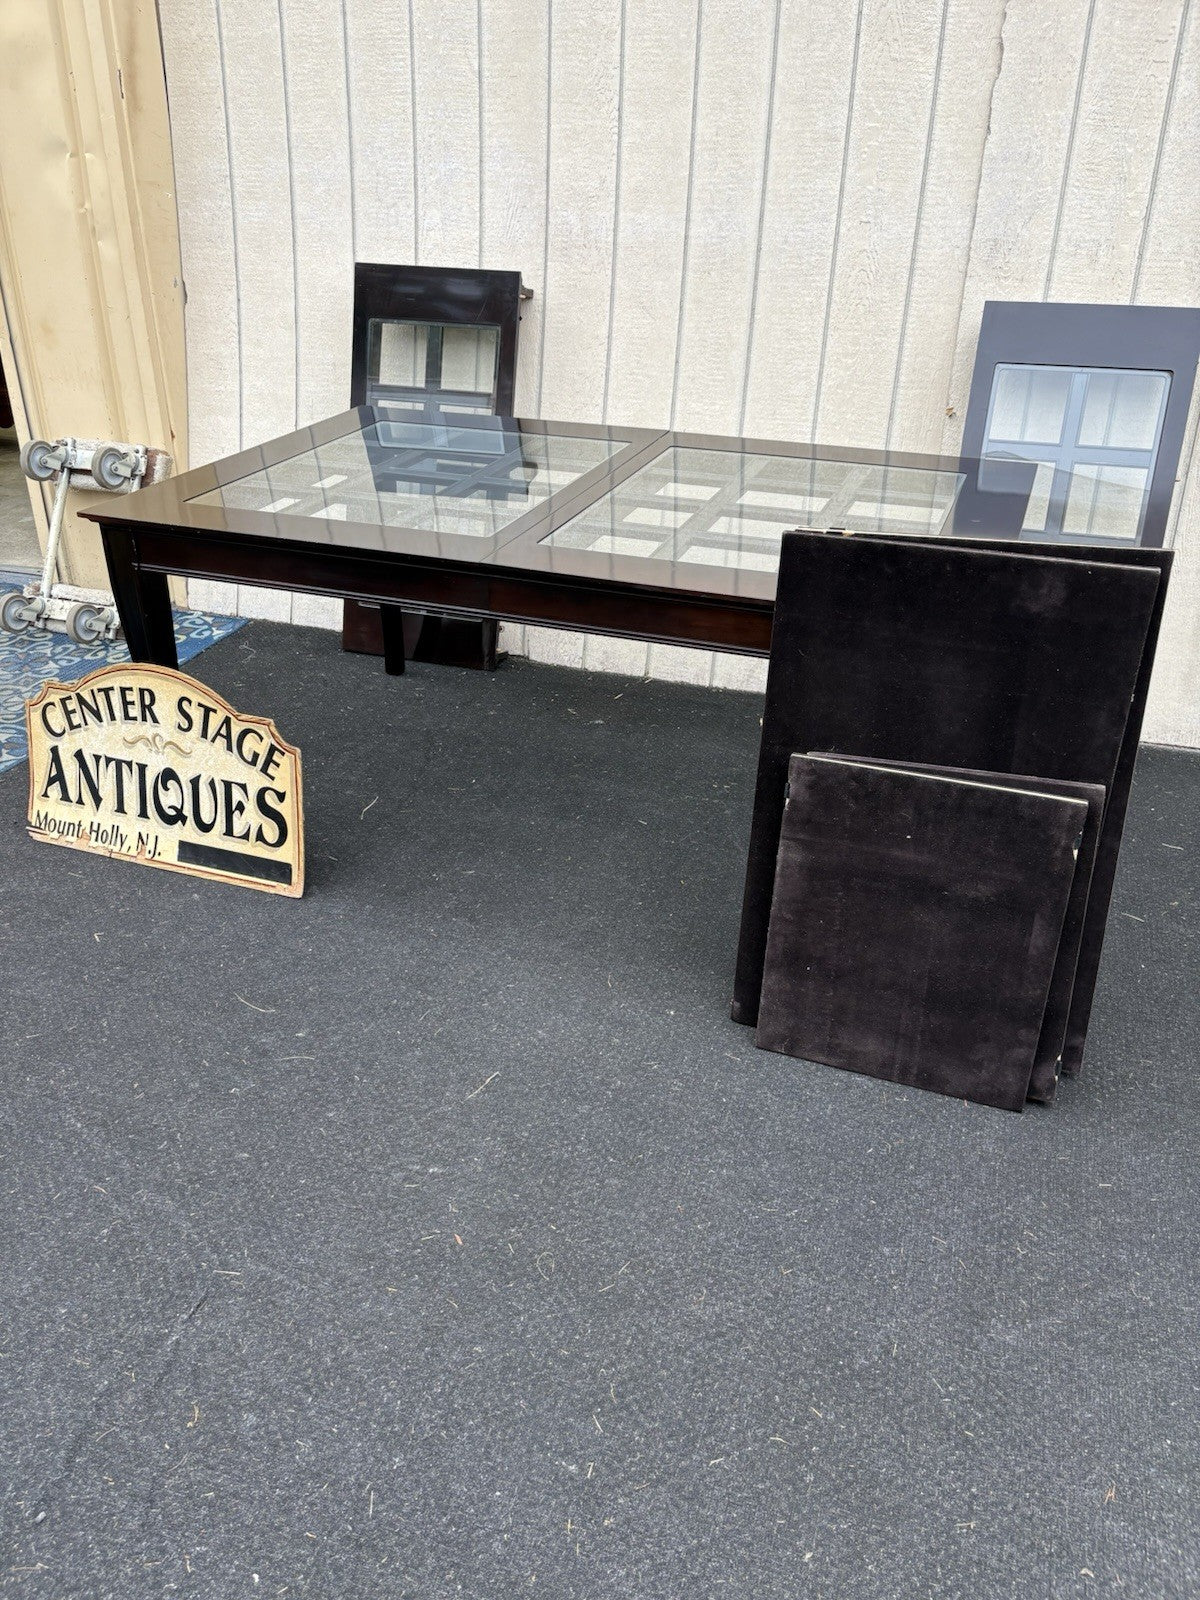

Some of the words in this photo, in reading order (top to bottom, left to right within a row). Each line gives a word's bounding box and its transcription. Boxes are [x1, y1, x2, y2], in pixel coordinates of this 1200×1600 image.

[41, 686, 160, 738] CENTER
[177, 696, 286, 781] STAGE
[35, 809, 82, 838] Mount
[89, 821, 131, 852] Holly,
[136, 831, 161, 859] N.J.
[41, 745, 288, 848] ANTIQUES
